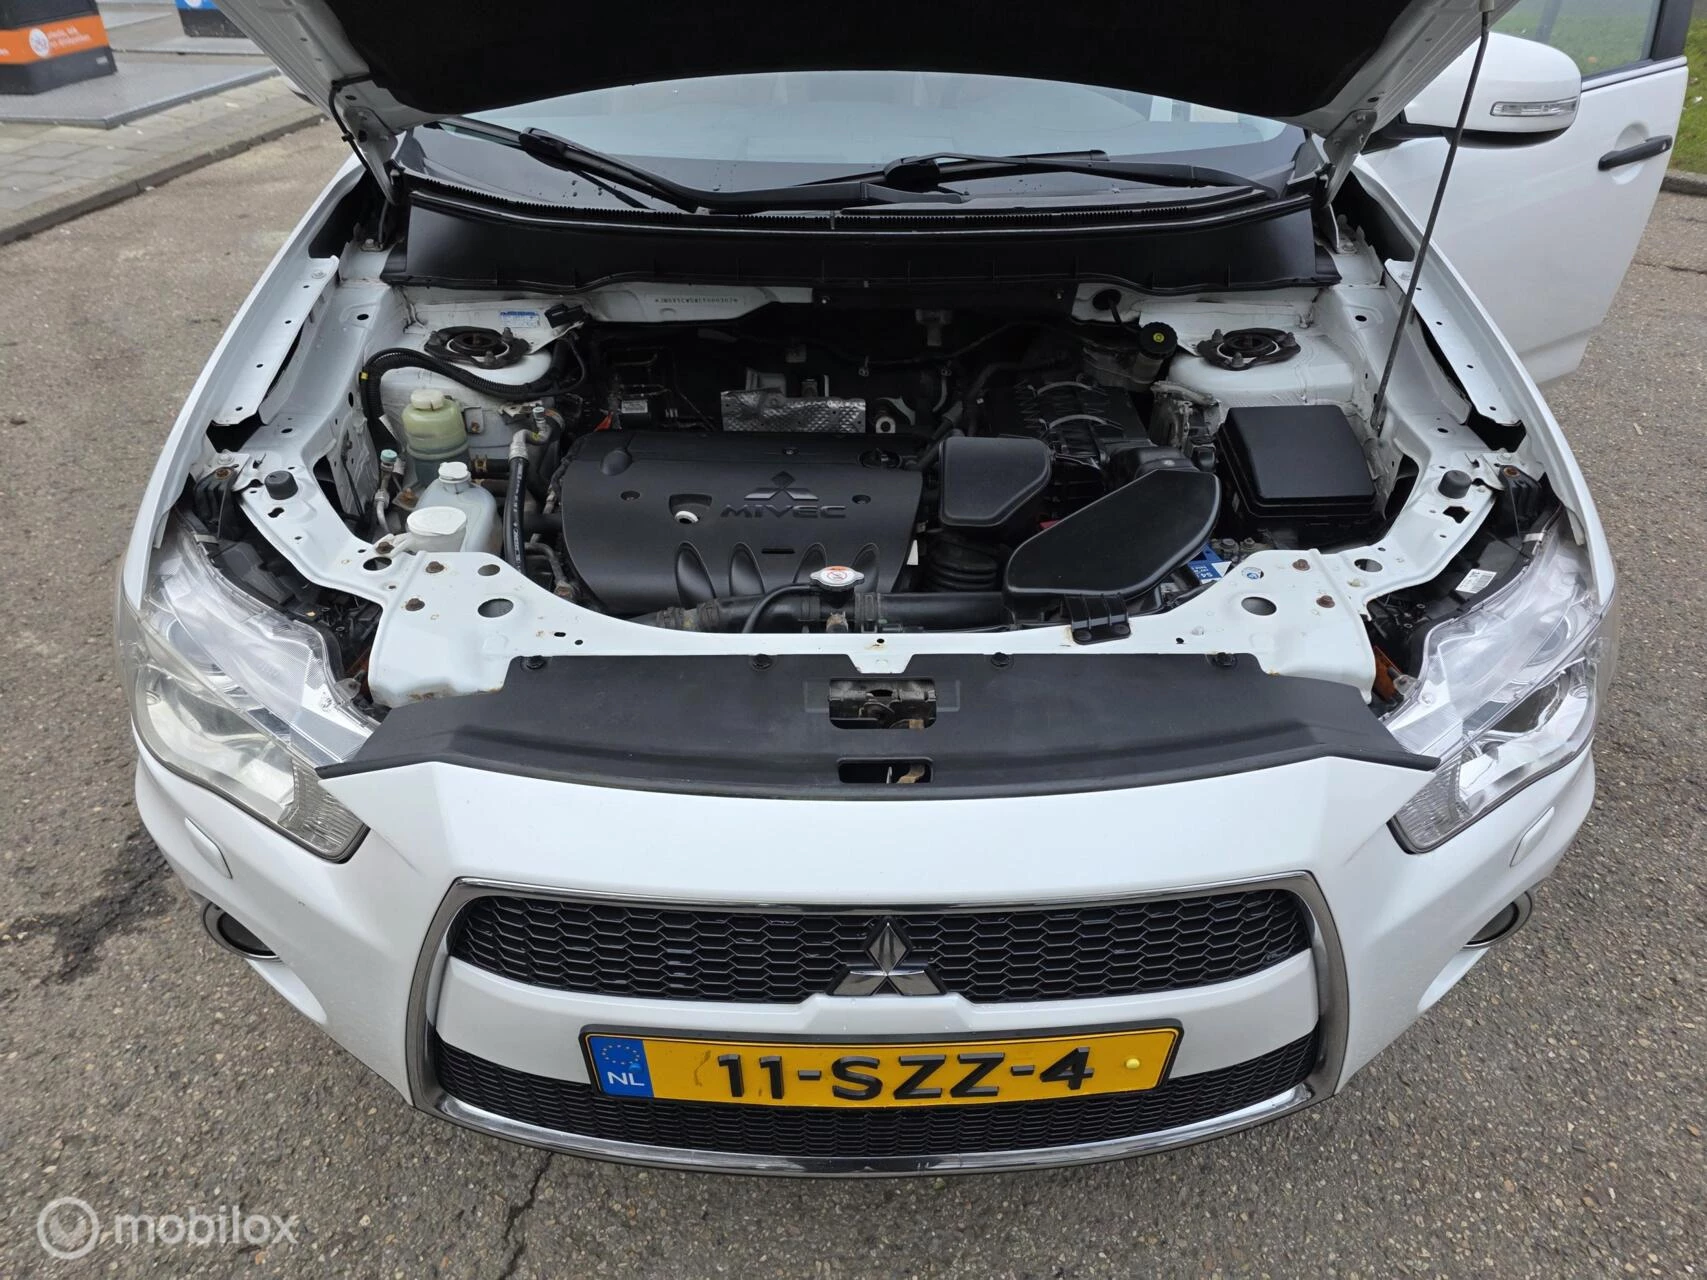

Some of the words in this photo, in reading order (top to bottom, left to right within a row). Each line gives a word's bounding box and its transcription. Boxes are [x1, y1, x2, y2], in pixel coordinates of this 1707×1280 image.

[720, 504, 846, 518] MIVEC
[608, 1071, 645, 1087] NL
[718, 1047, 1094, 1100] 11-SZZ-4
